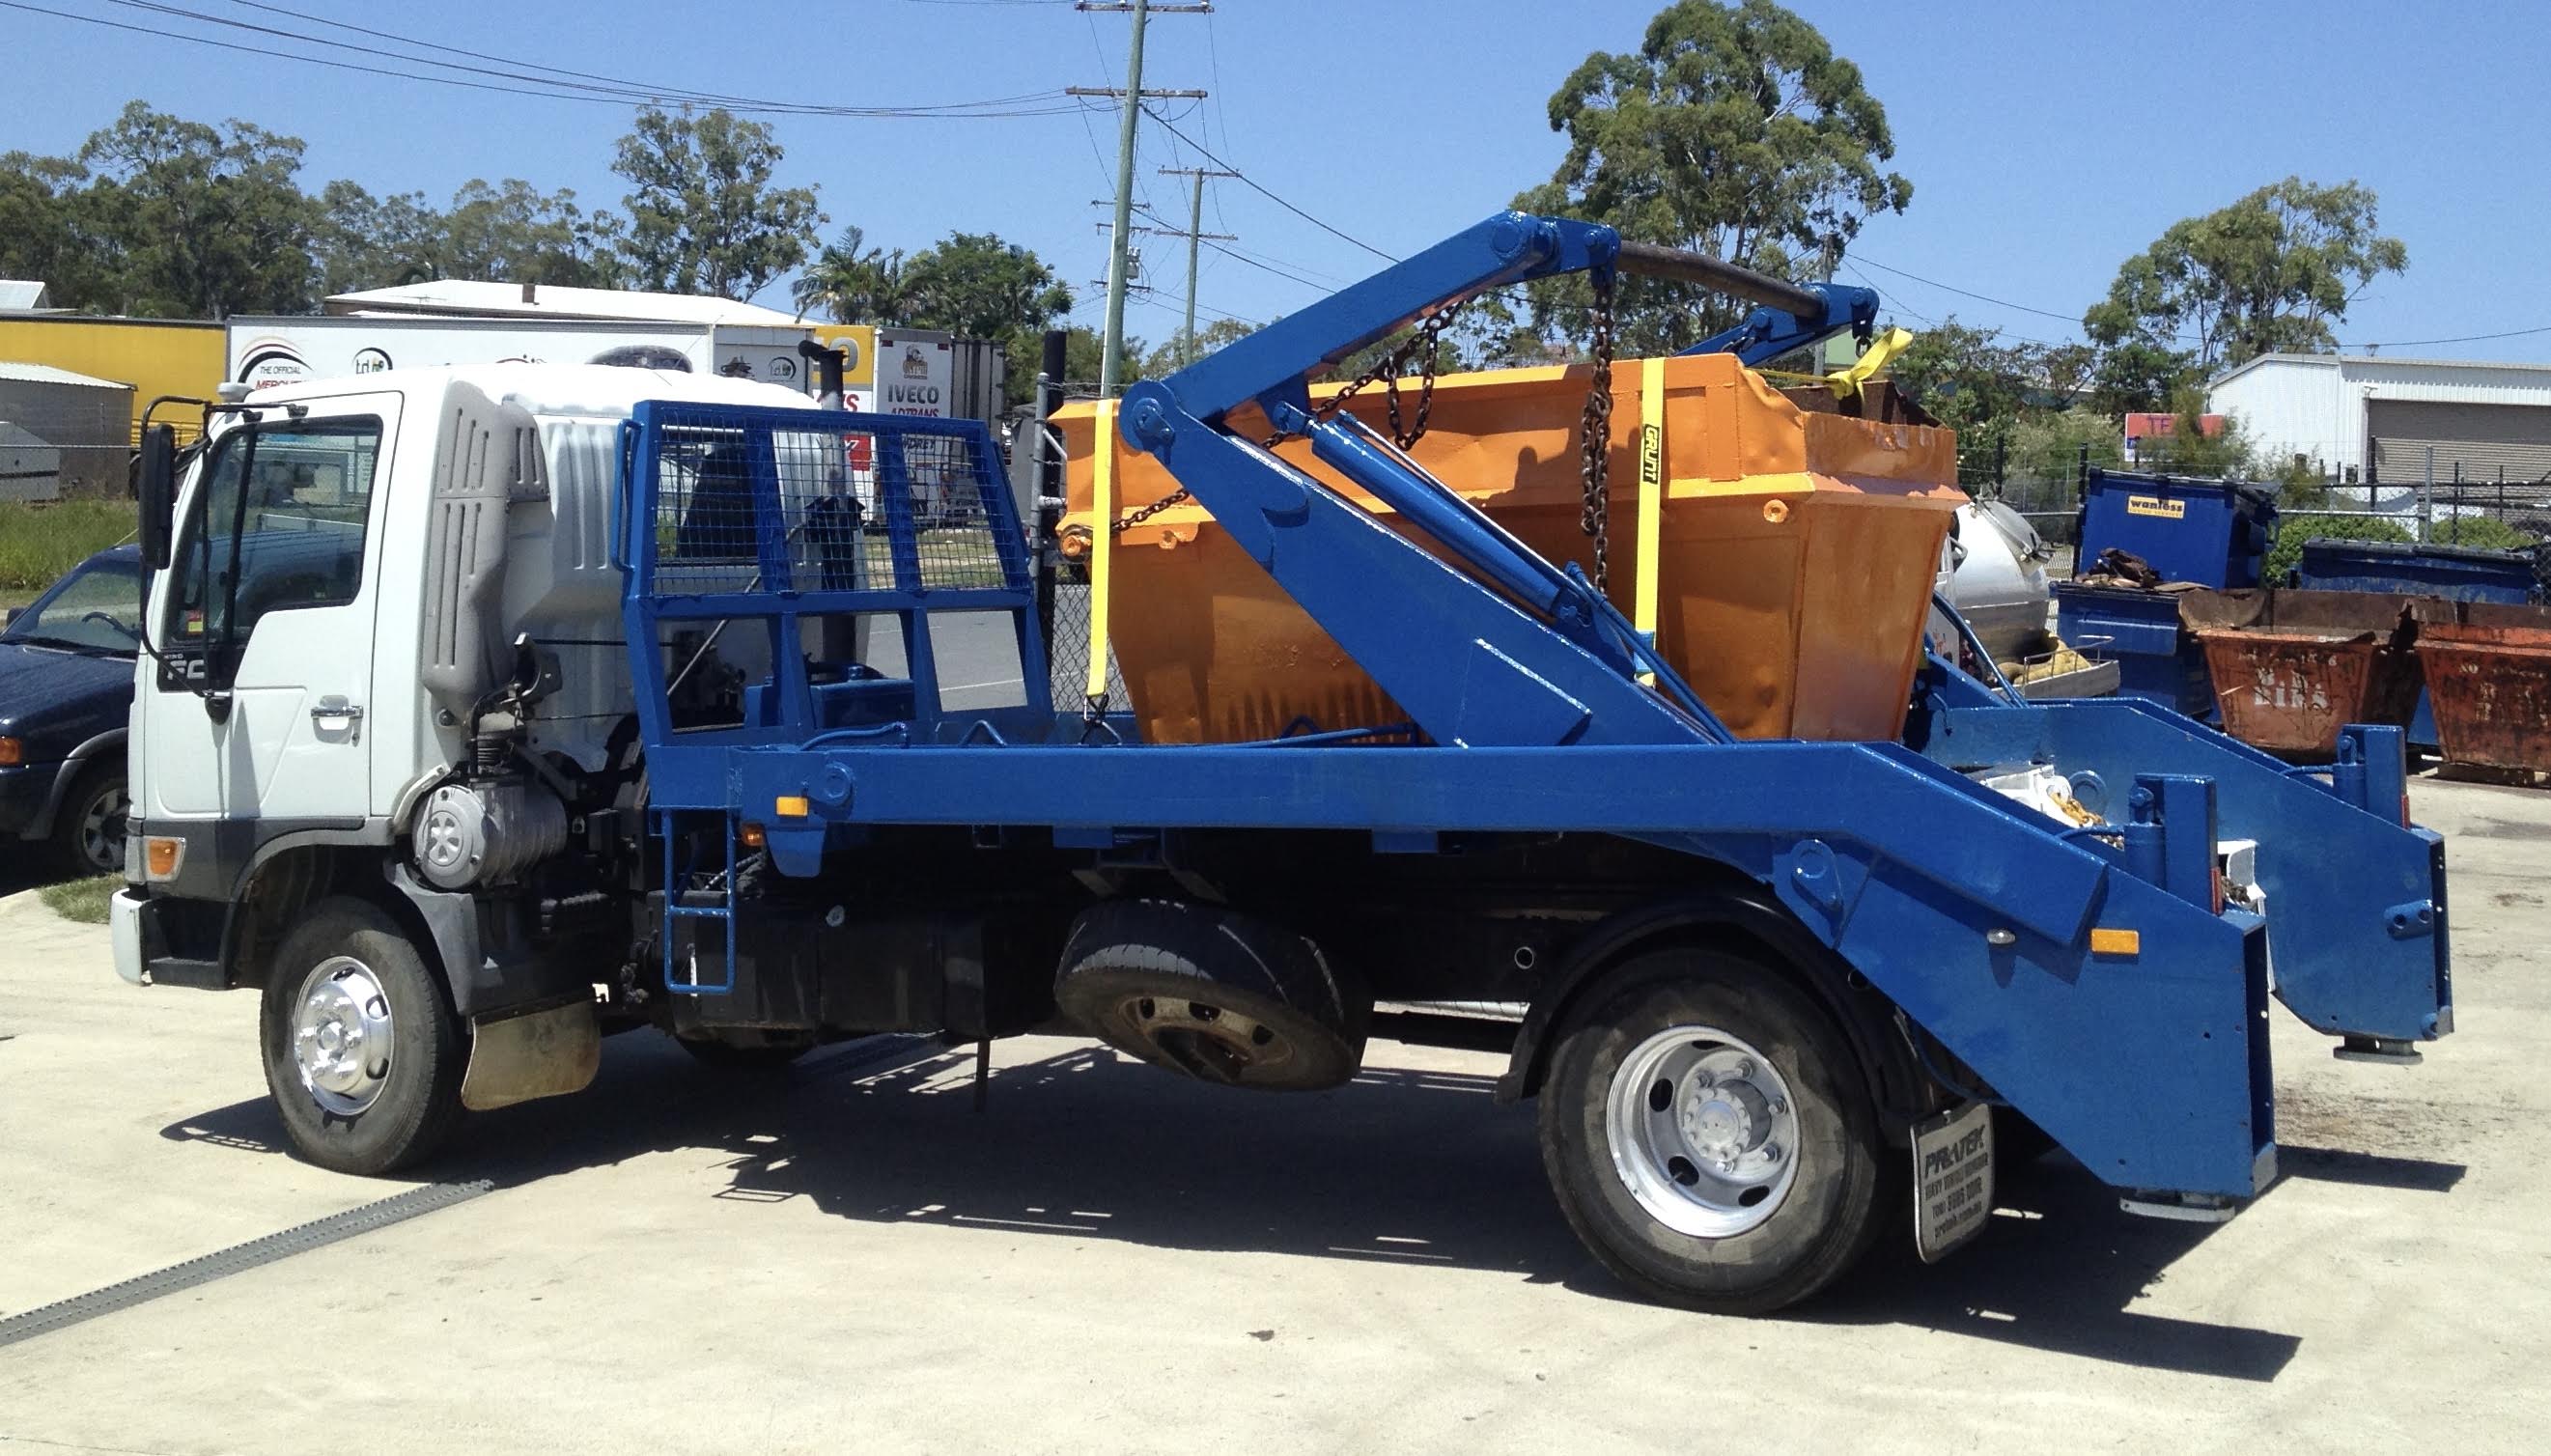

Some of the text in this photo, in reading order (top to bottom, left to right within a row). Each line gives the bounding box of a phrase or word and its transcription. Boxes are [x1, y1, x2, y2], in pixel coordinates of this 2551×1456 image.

[260, 366, 301, 375] THE OFFICIAL
[888, 385, 939, 404] IVECO
[2130, 500, 2183, 512] wanless
